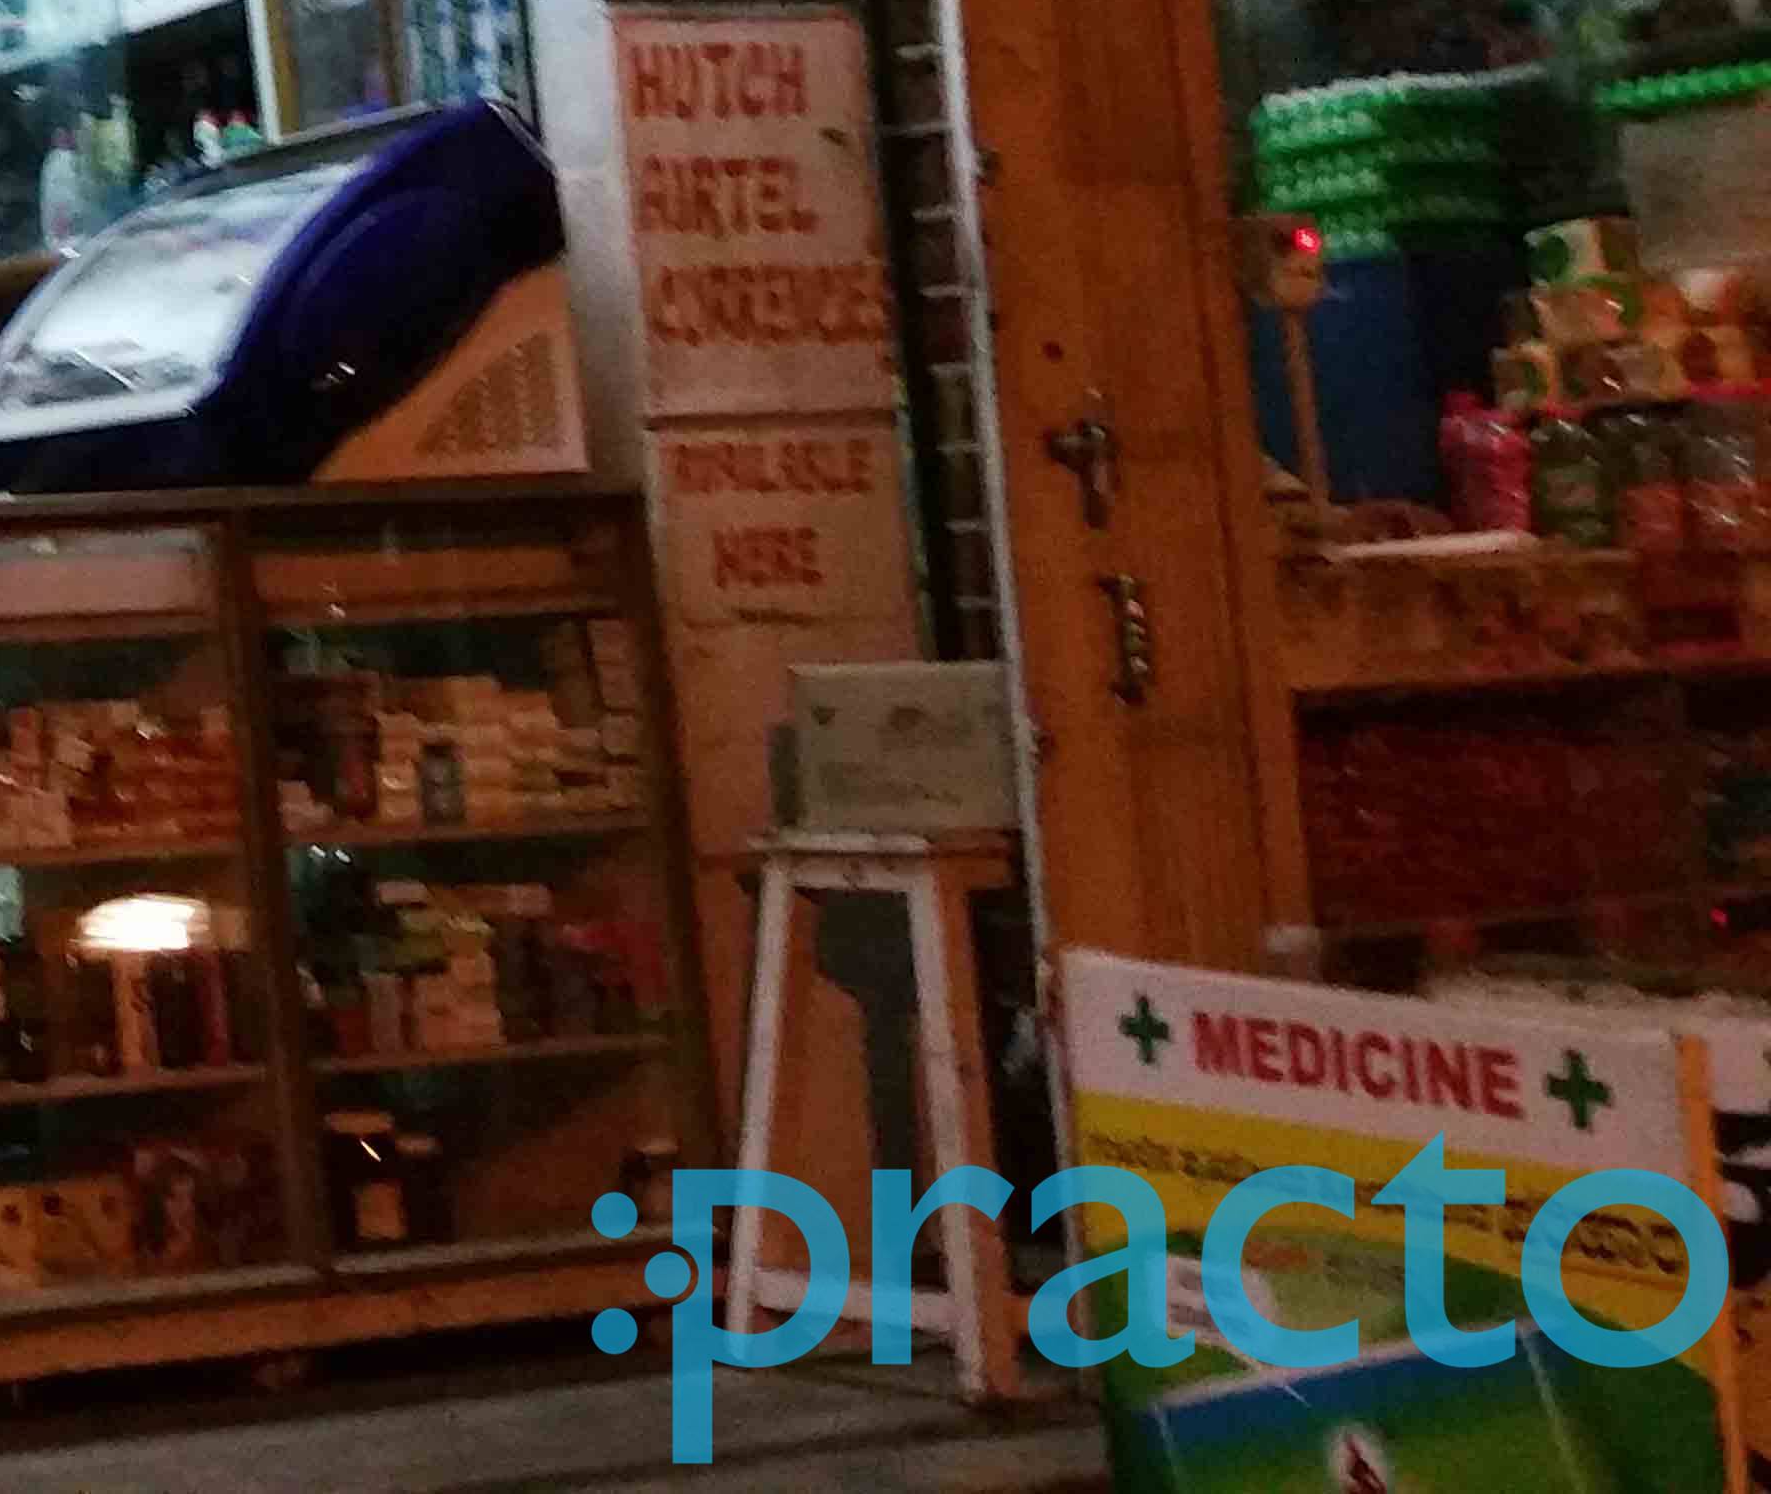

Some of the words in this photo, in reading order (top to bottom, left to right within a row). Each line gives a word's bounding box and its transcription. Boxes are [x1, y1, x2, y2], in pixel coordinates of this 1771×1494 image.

[629, 42, 809, 119] HUTCH
[635, 156, 817, 238] AIRTEL
[712, 521, 825, 589] HERE
[1191, 1009, 1526, 1122] MEDICINE
